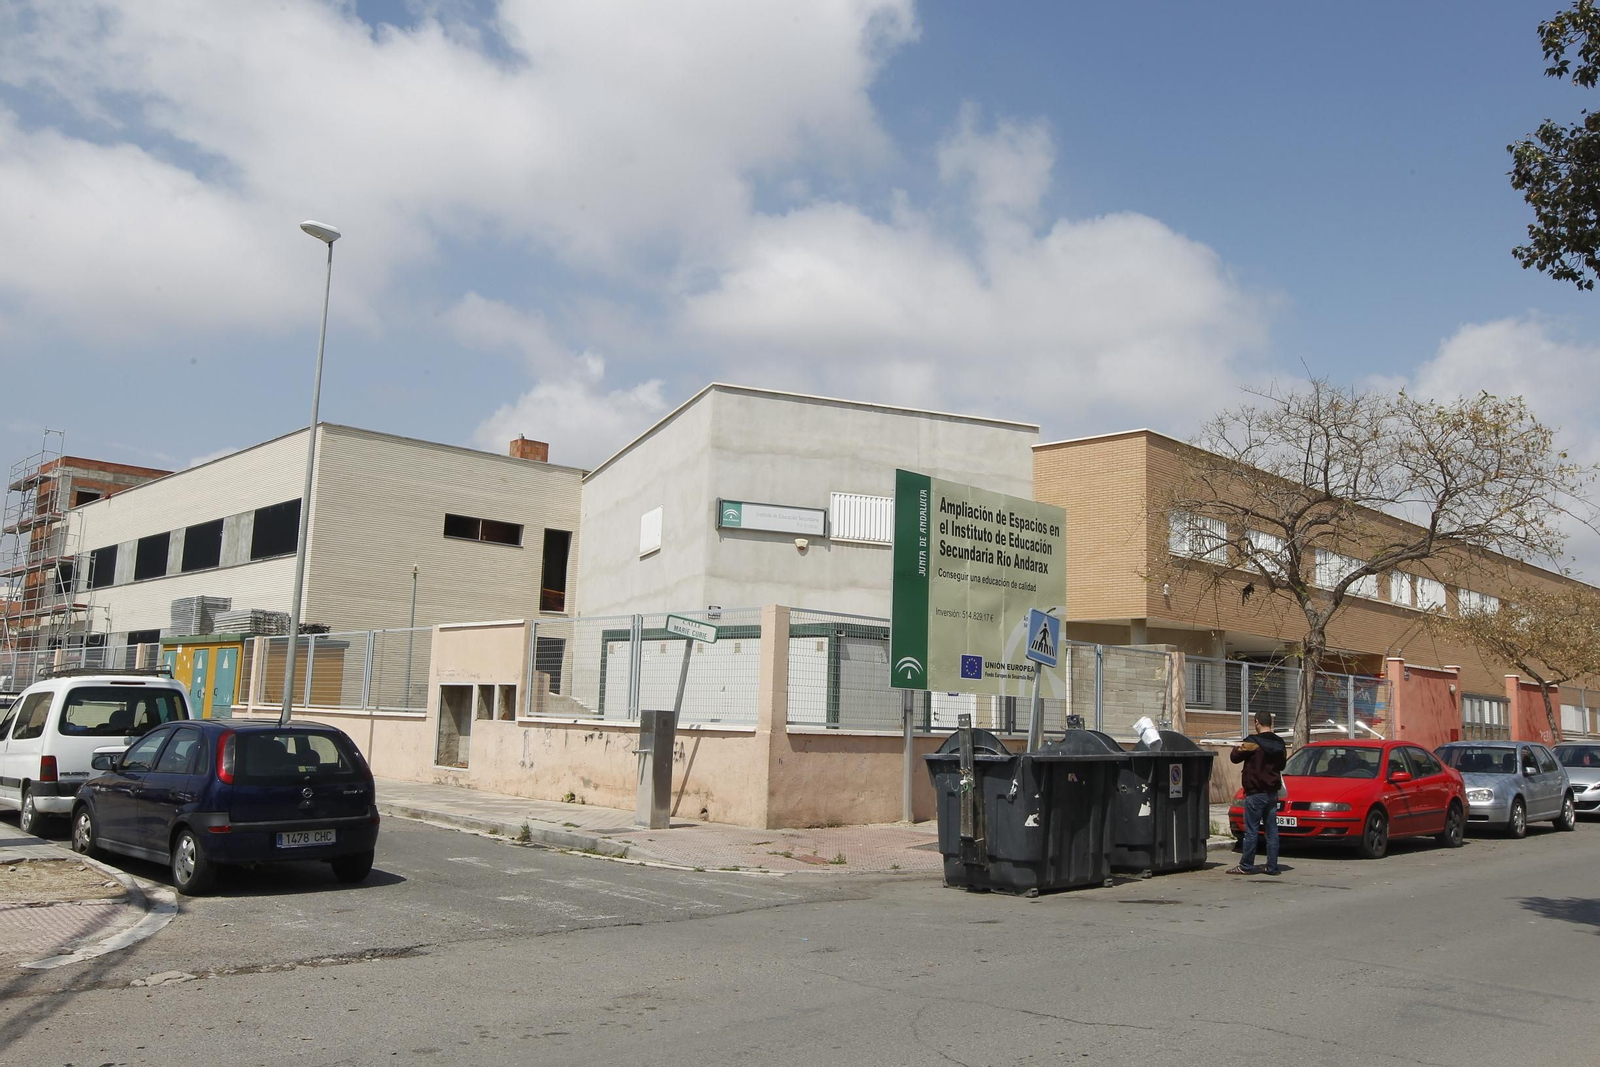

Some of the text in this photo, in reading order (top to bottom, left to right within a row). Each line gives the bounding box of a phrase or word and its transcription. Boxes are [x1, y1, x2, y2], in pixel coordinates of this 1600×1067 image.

[940, 496, 1060, 537] Ampliación de Espacios en
[920, 536, 927, 547] DE
[940, 520, 1052, 555] el Instituto de Educación
[939, 540, 1049, 574] Secundaria Río Andarax
[938, 568, 1037, 592] Conseguir una educación de calidad
[935, 607, 961, 618] Inversión:
[673, 625, 708, 640] MARIE CURIE
[985, 661, 1035, 672] UNIÓN EUROPEA
[286, 831, 332, 844] 1478 CHC
